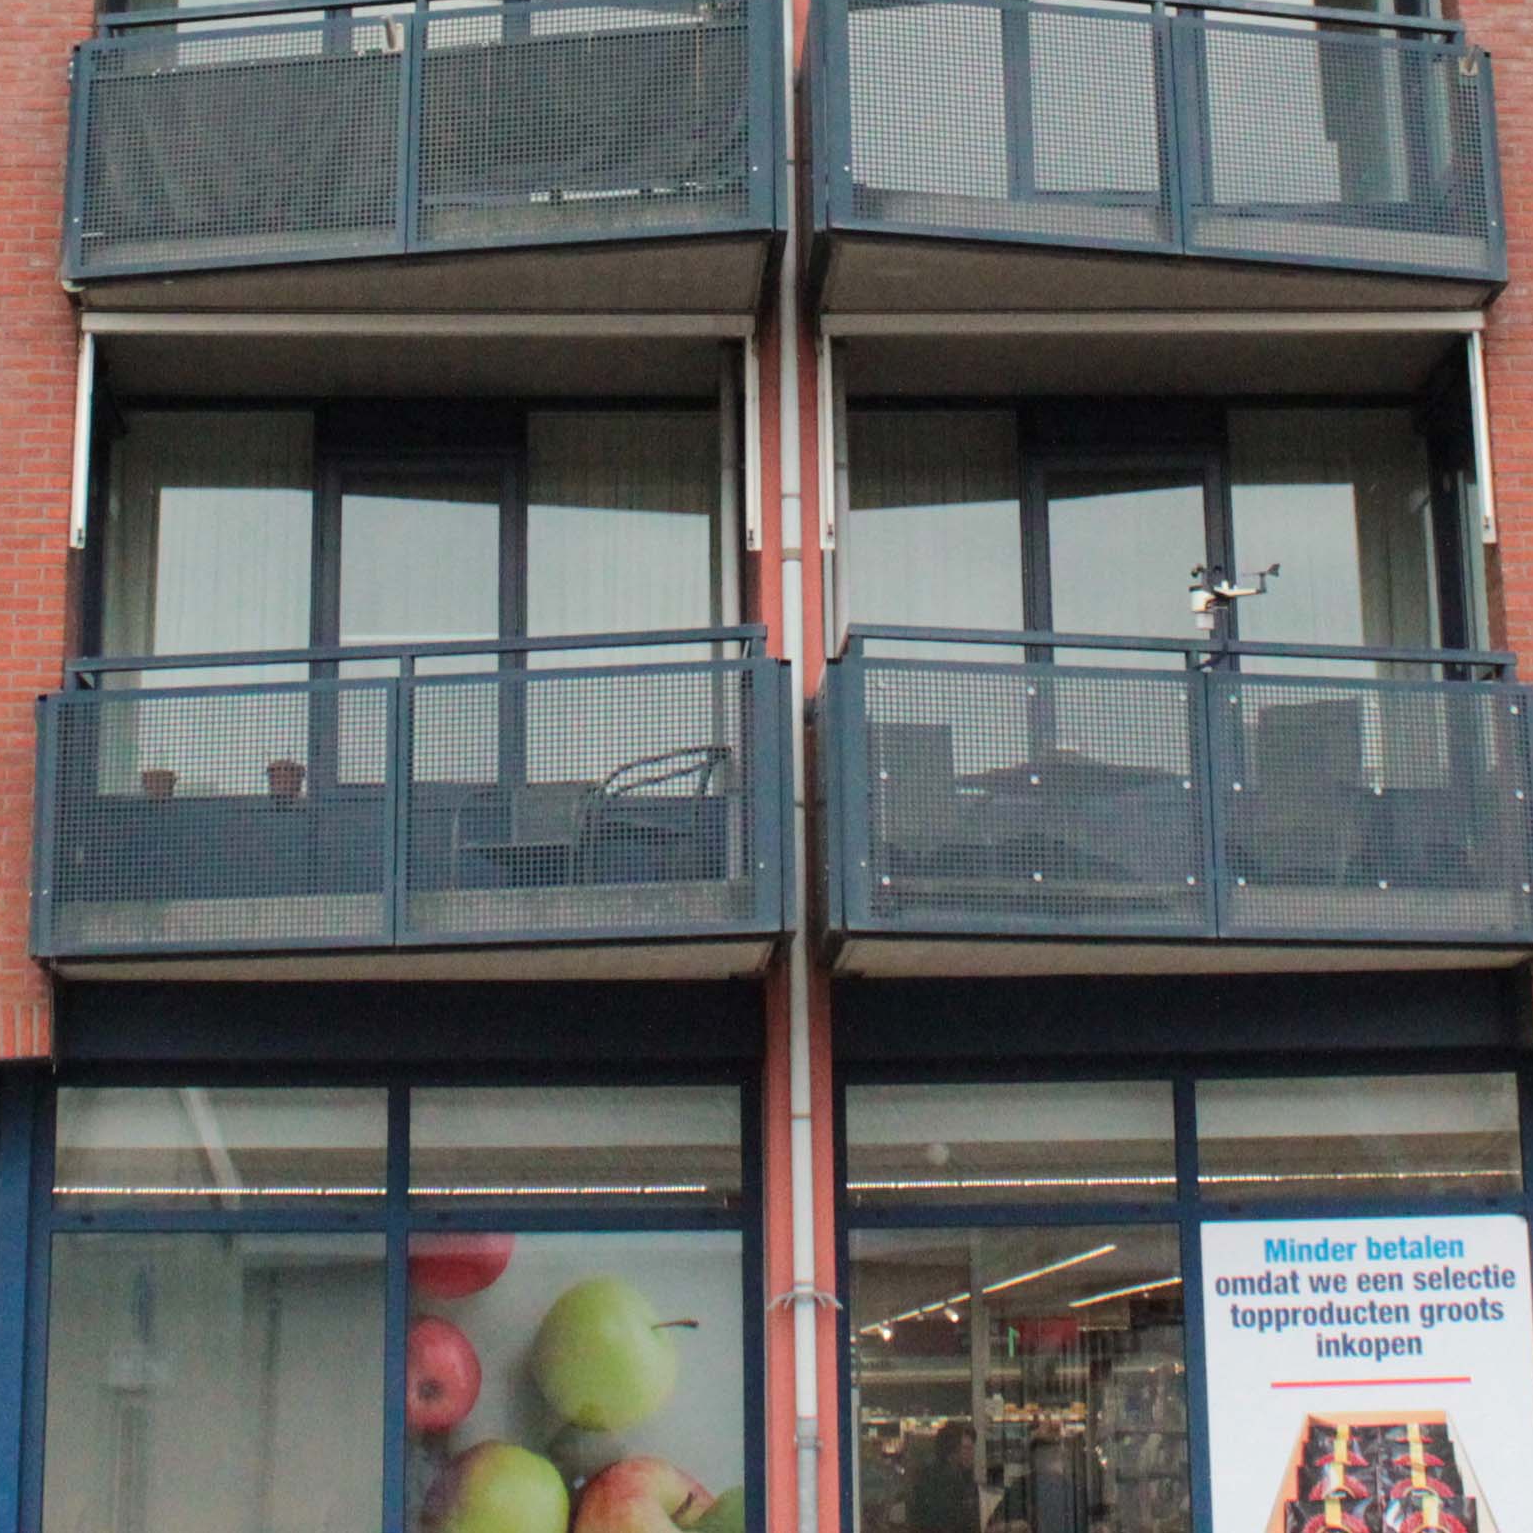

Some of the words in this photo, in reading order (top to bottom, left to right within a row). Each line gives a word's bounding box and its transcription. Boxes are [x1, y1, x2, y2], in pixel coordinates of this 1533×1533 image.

[1264, 1238, 1357, 1263] Minder
[1366, 1235, 1464, 1261] betalen
[1215, 1270, 1300, 1296] omdat
[1309, 1274, 1347, 1294] we
[1357, 1273, 1403, 1293] een
[1413, 1266, 1516, 1291] selectie
[1231, 1300, 1410, 1332] topproducten
[1420, 1297, 1504, 1328] groots
[1317, 1334, 1423, 1362] inkopen
